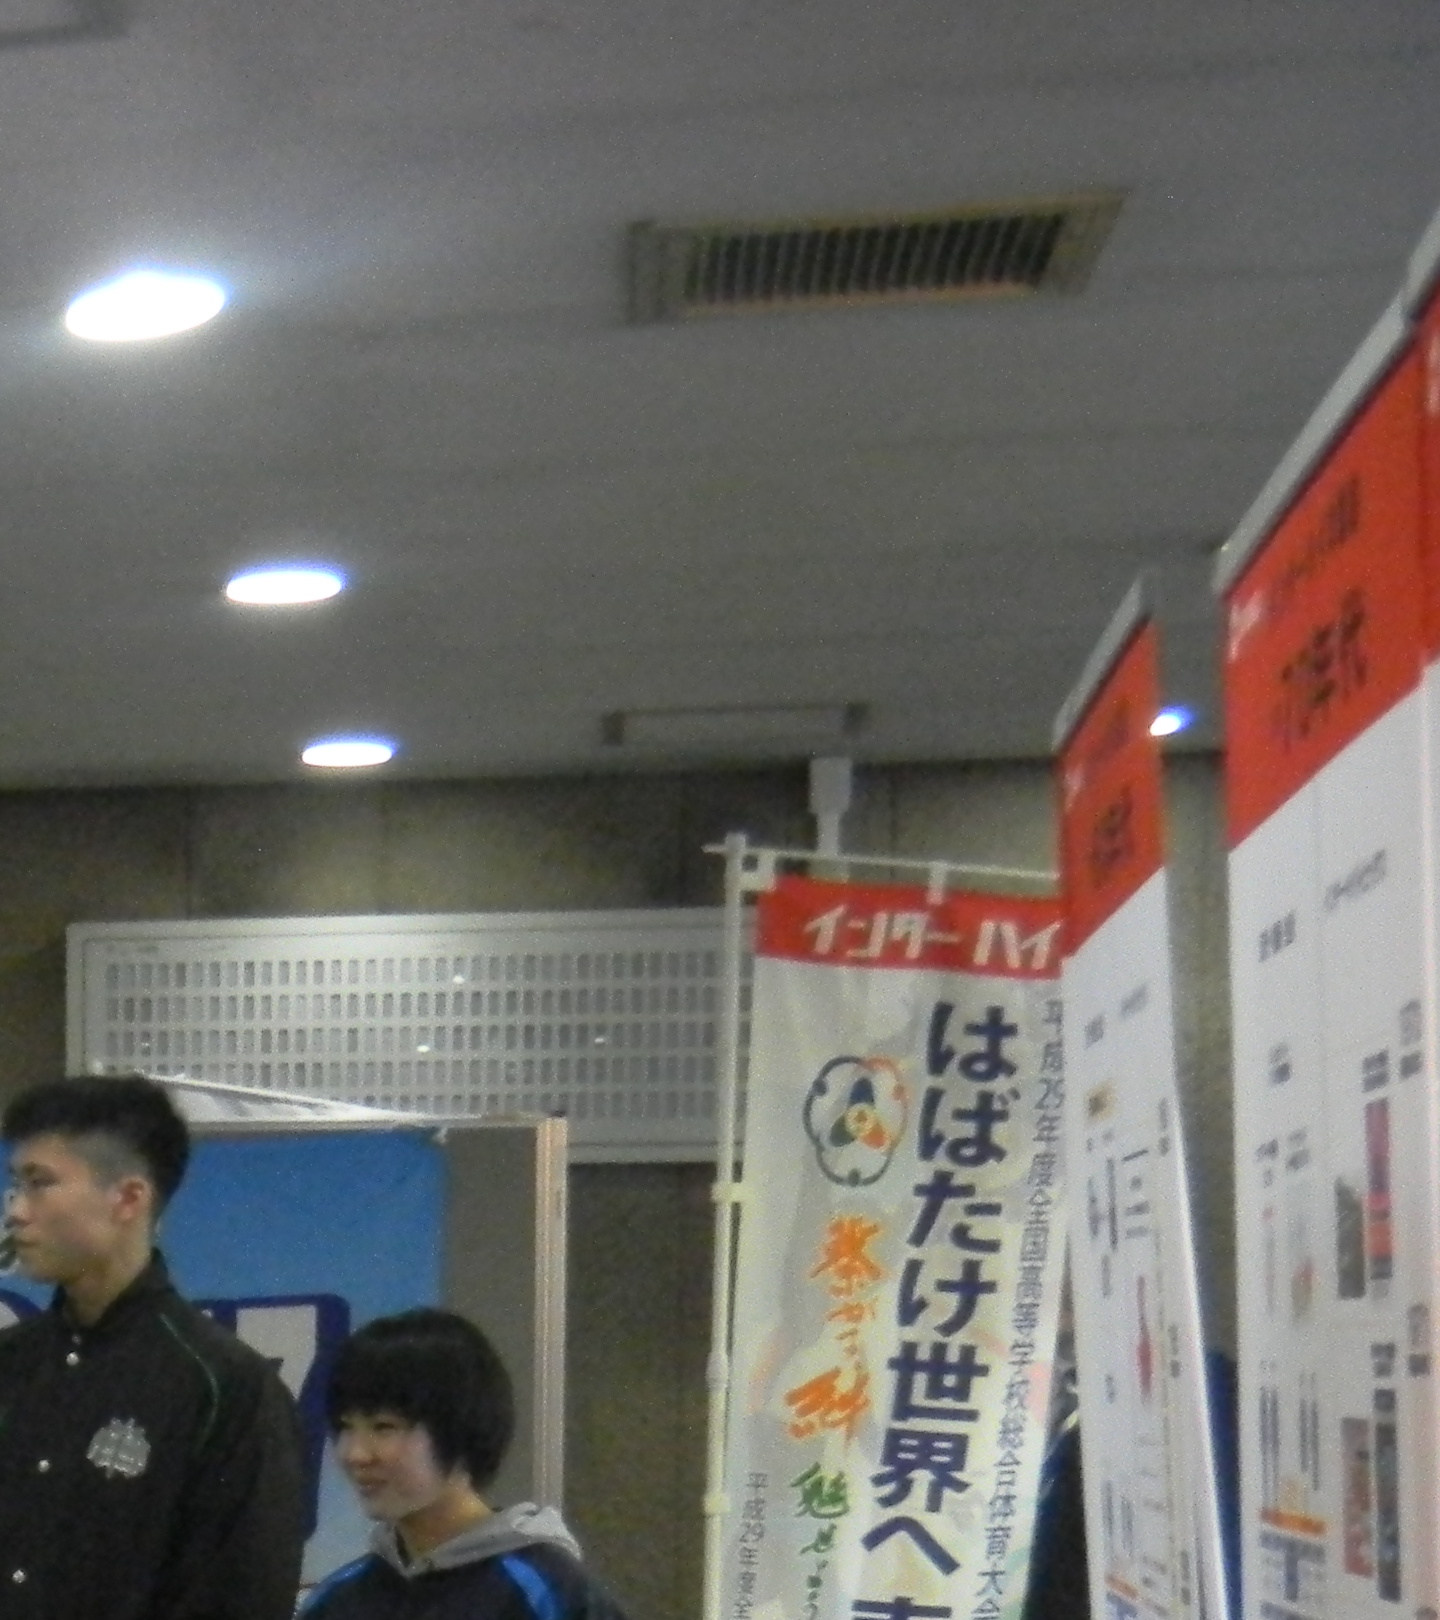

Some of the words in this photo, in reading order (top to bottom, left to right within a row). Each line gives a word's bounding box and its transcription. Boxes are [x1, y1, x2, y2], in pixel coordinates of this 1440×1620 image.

[803, 903, 1063, 970] インターハイ
